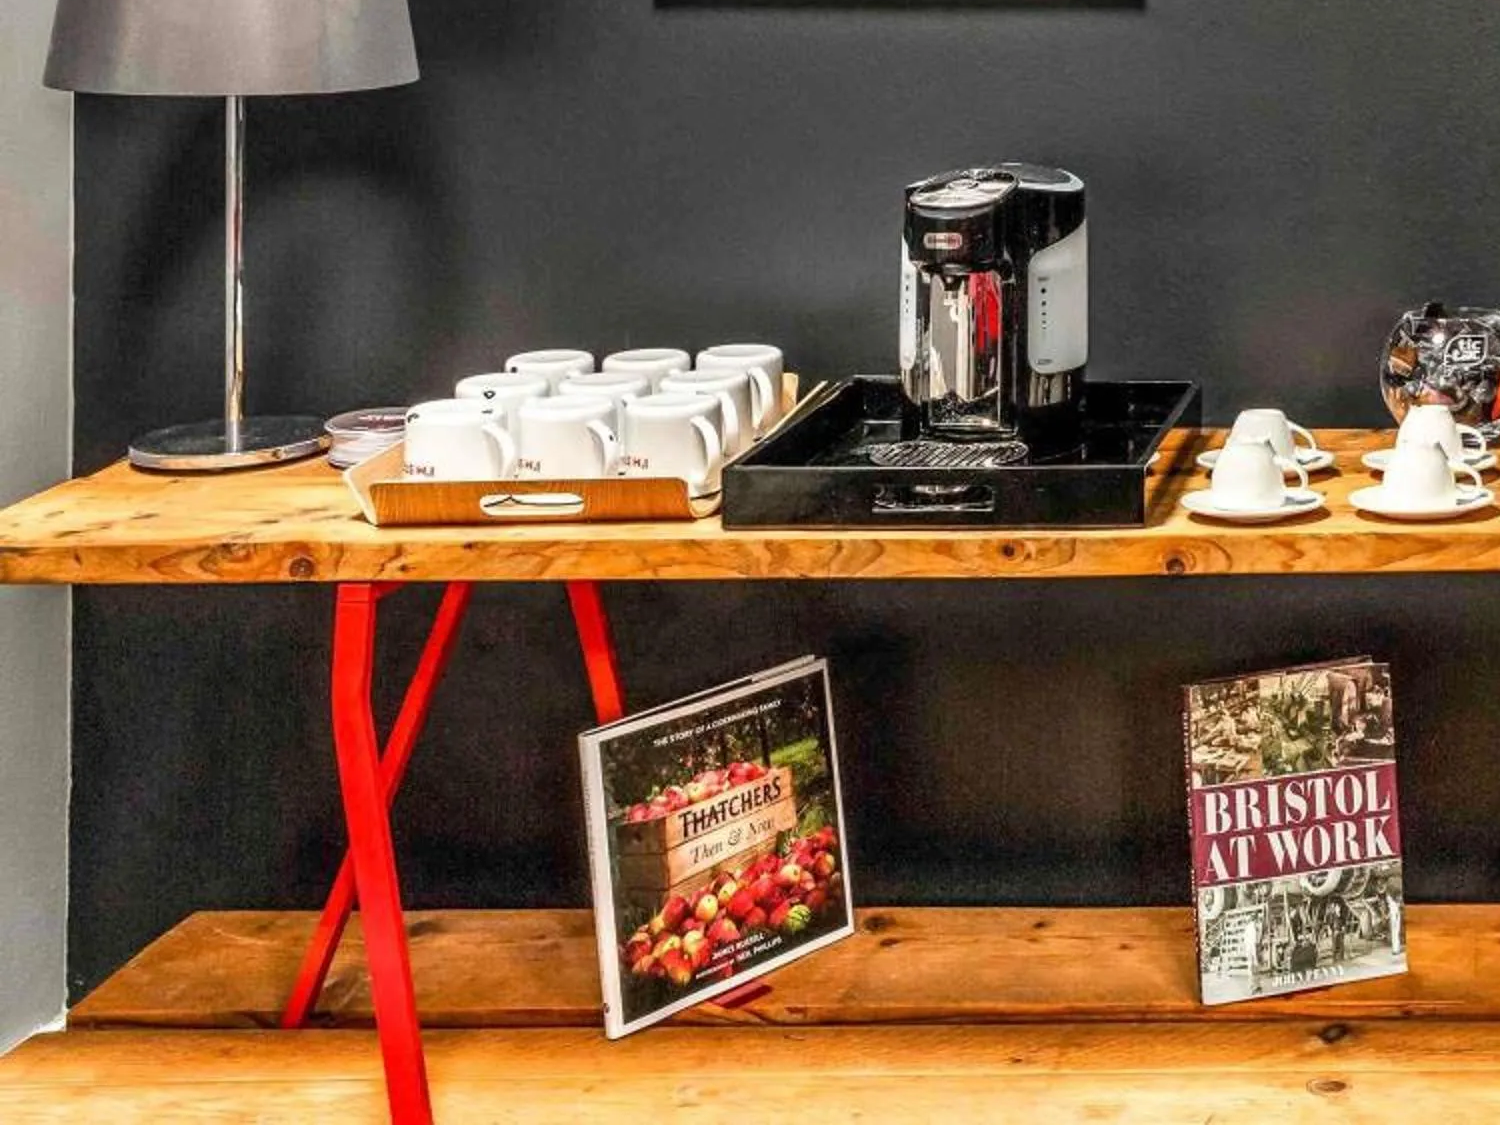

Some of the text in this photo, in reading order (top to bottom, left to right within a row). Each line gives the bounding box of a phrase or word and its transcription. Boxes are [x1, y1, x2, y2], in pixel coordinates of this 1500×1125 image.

[678, 776, 781, 838] THATCHERS
[1203, 771, 1391, 835] BRISTOL
[690, 842, 723, 864] Then
[727, 828, 742, 846] &
[1198, 815, 1395, 884] AT WORK
